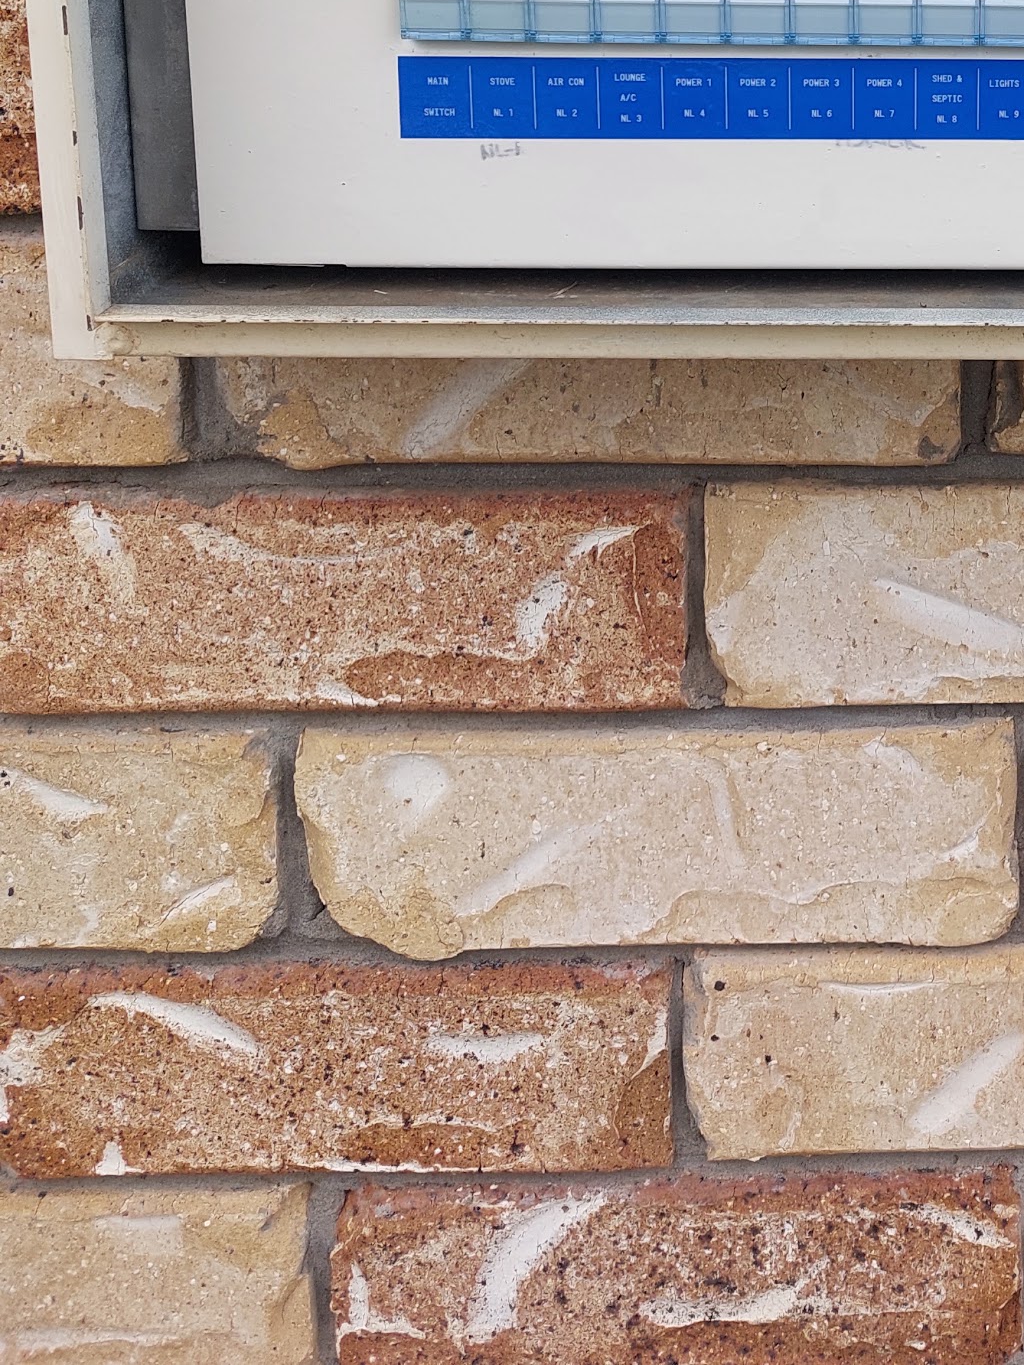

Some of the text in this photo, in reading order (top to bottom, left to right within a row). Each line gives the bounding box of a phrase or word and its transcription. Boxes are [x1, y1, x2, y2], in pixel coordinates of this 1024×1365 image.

[427, 77, 449, 86] MAIN
[490, 77, 516, 86] STOVE
[548, 78, 585, 86] AIR CON
[614, 73, 646, 82] LOUNGE
[932, 74, 963, 83] SHED &
[675, 78, 713, 87] POWER 1
[739, 78, 776, 87] POWER 2
[803, 79, 840, 87] POWER 3
[866, 79, 903, 87] POWER 4
[989, 79, 1020, 88] LIGHTS
[620, 93, 637, 102] A/C
[931, 94, 963, 103] SEPTIC
[423, 108, 456, 117] SWITCH
[493, 108, 514, 117] NL 1
[556, 109, 578, 117] NL 2
[684, 109, 706, 118] NL 4
[748, 109, 769, 118] NL 5
[811, 109, 833, 118] NL 6
[874, 109, 895, 118] NL 7
[998, 110, 1020, 119] NL 9
[620, 114, 642, 123] NL 3
[936, 115, 958, 124] NL 8
